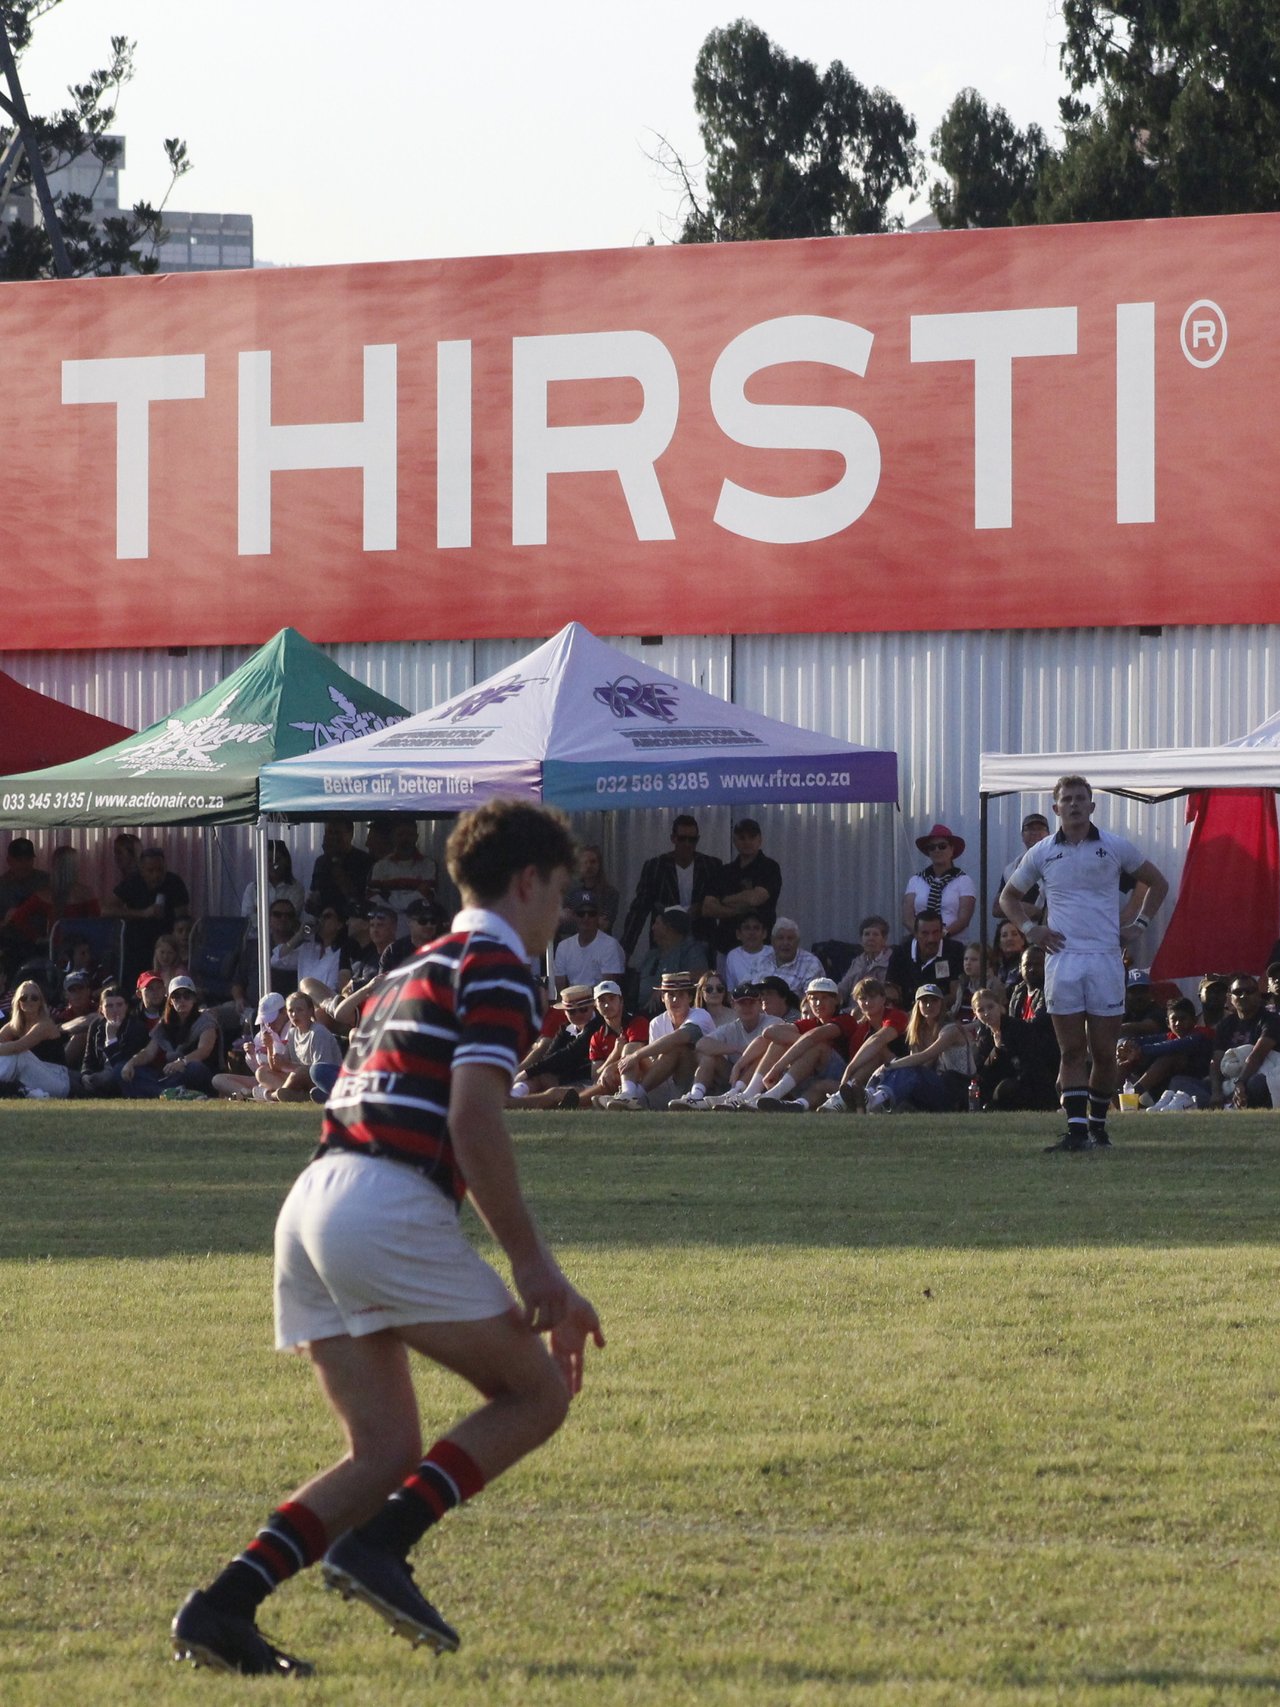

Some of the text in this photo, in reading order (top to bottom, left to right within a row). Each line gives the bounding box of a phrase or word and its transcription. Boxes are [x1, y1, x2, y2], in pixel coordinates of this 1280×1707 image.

[323, 774, 475, 796] Better air, better life!
[596, 769, 851, 794] 032 586 3285 www.rfra.co.za
[3, 793, 25, 810] 033
[28, 792, 51, 810] 345
[53, 791, 86, 809] 3135
[94, 791, 224, 809] www.actionair.co.za
